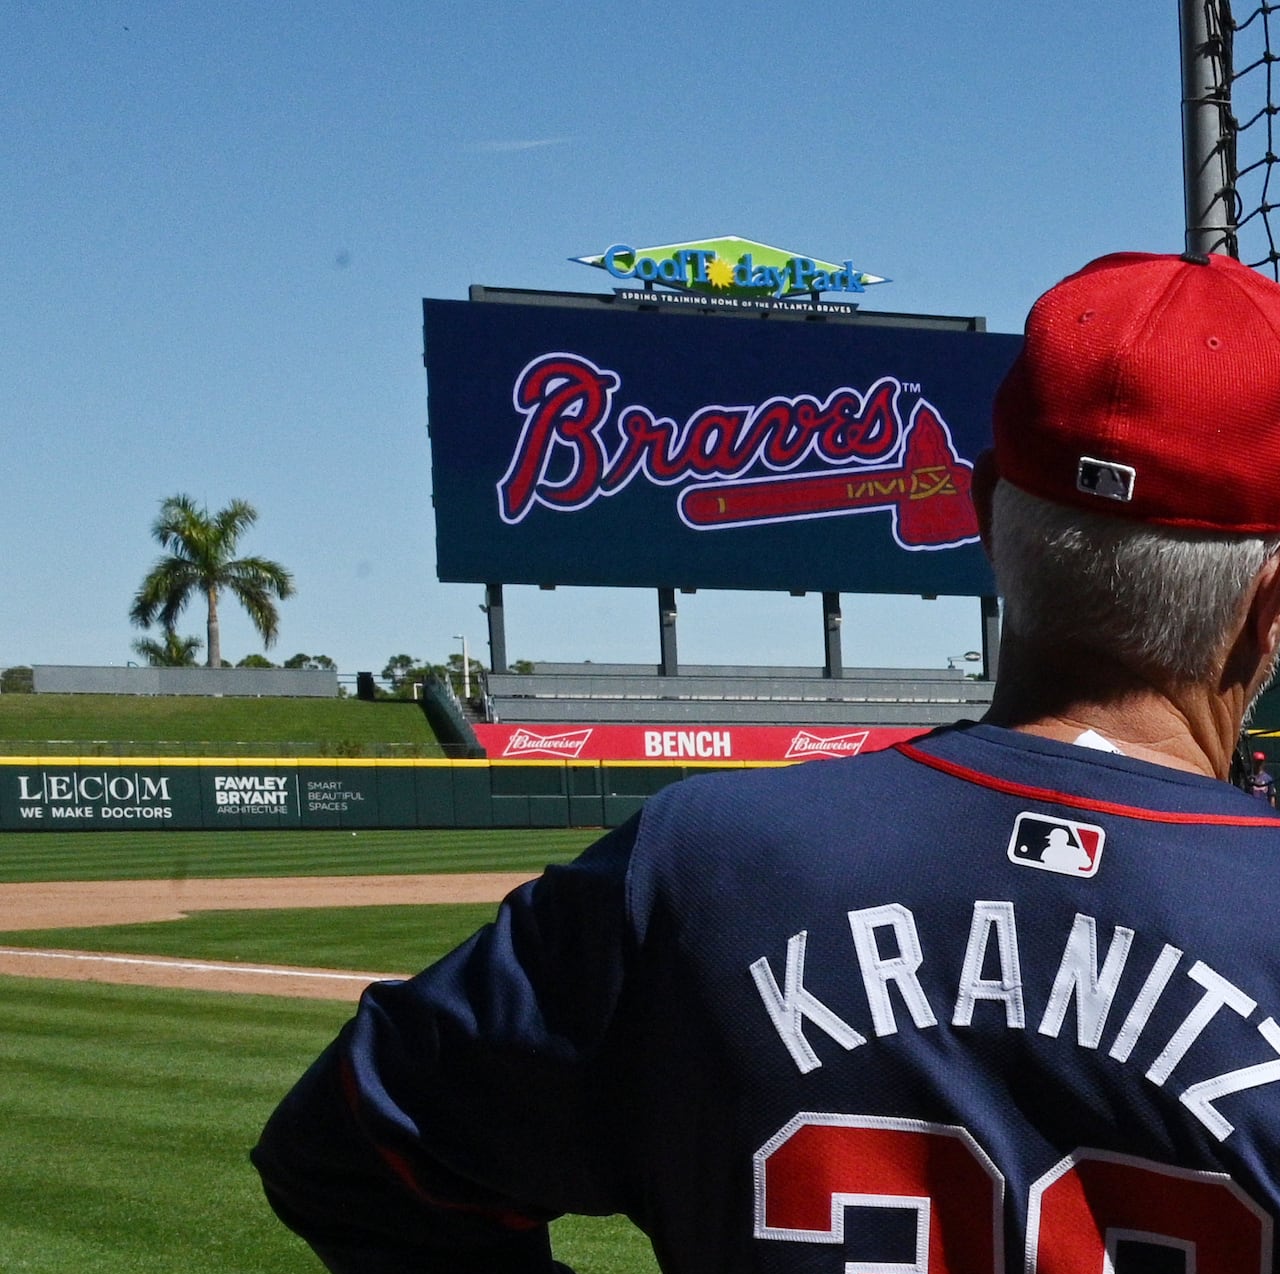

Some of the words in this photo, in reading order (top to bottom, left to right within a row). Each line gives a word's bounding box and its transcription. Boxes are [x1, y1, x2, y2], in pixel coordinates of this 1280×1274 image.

[790, 257, 866, 293] Park
[621, 292, 658, 302] SPRING
[661, 294, 708, 305] TRAINING
[710, 297, 738, 307] HOME
[755, 301, 770, 309] THE
[772, 301, 814, 312] ATLANTA
[816, 304, 852, 314] BRAVES
[496, 351, 902, 525] Braves
[512, 734, 584, 750] Budweiser
[644, 730, 732, 757] BENCH
[788, 735, 862, 752] Budweiser
[18, 774, 172, 803] LECOM
[215, 777, 288, 791] FAWLEY
[307, 780, 342, 791] SMART
[215, 791, 288, 805] BRYANT
[308, 791, 365, 801] BEAUTIFUL
[20, 806, 43, 819] WE
[51, 806, 94, 819] MAKE
[102, 806, 173, 819] DOCTORS
[216, 805, 288, 815] ARCHITECTURE
[308, 801, 348, 812] SPACES
